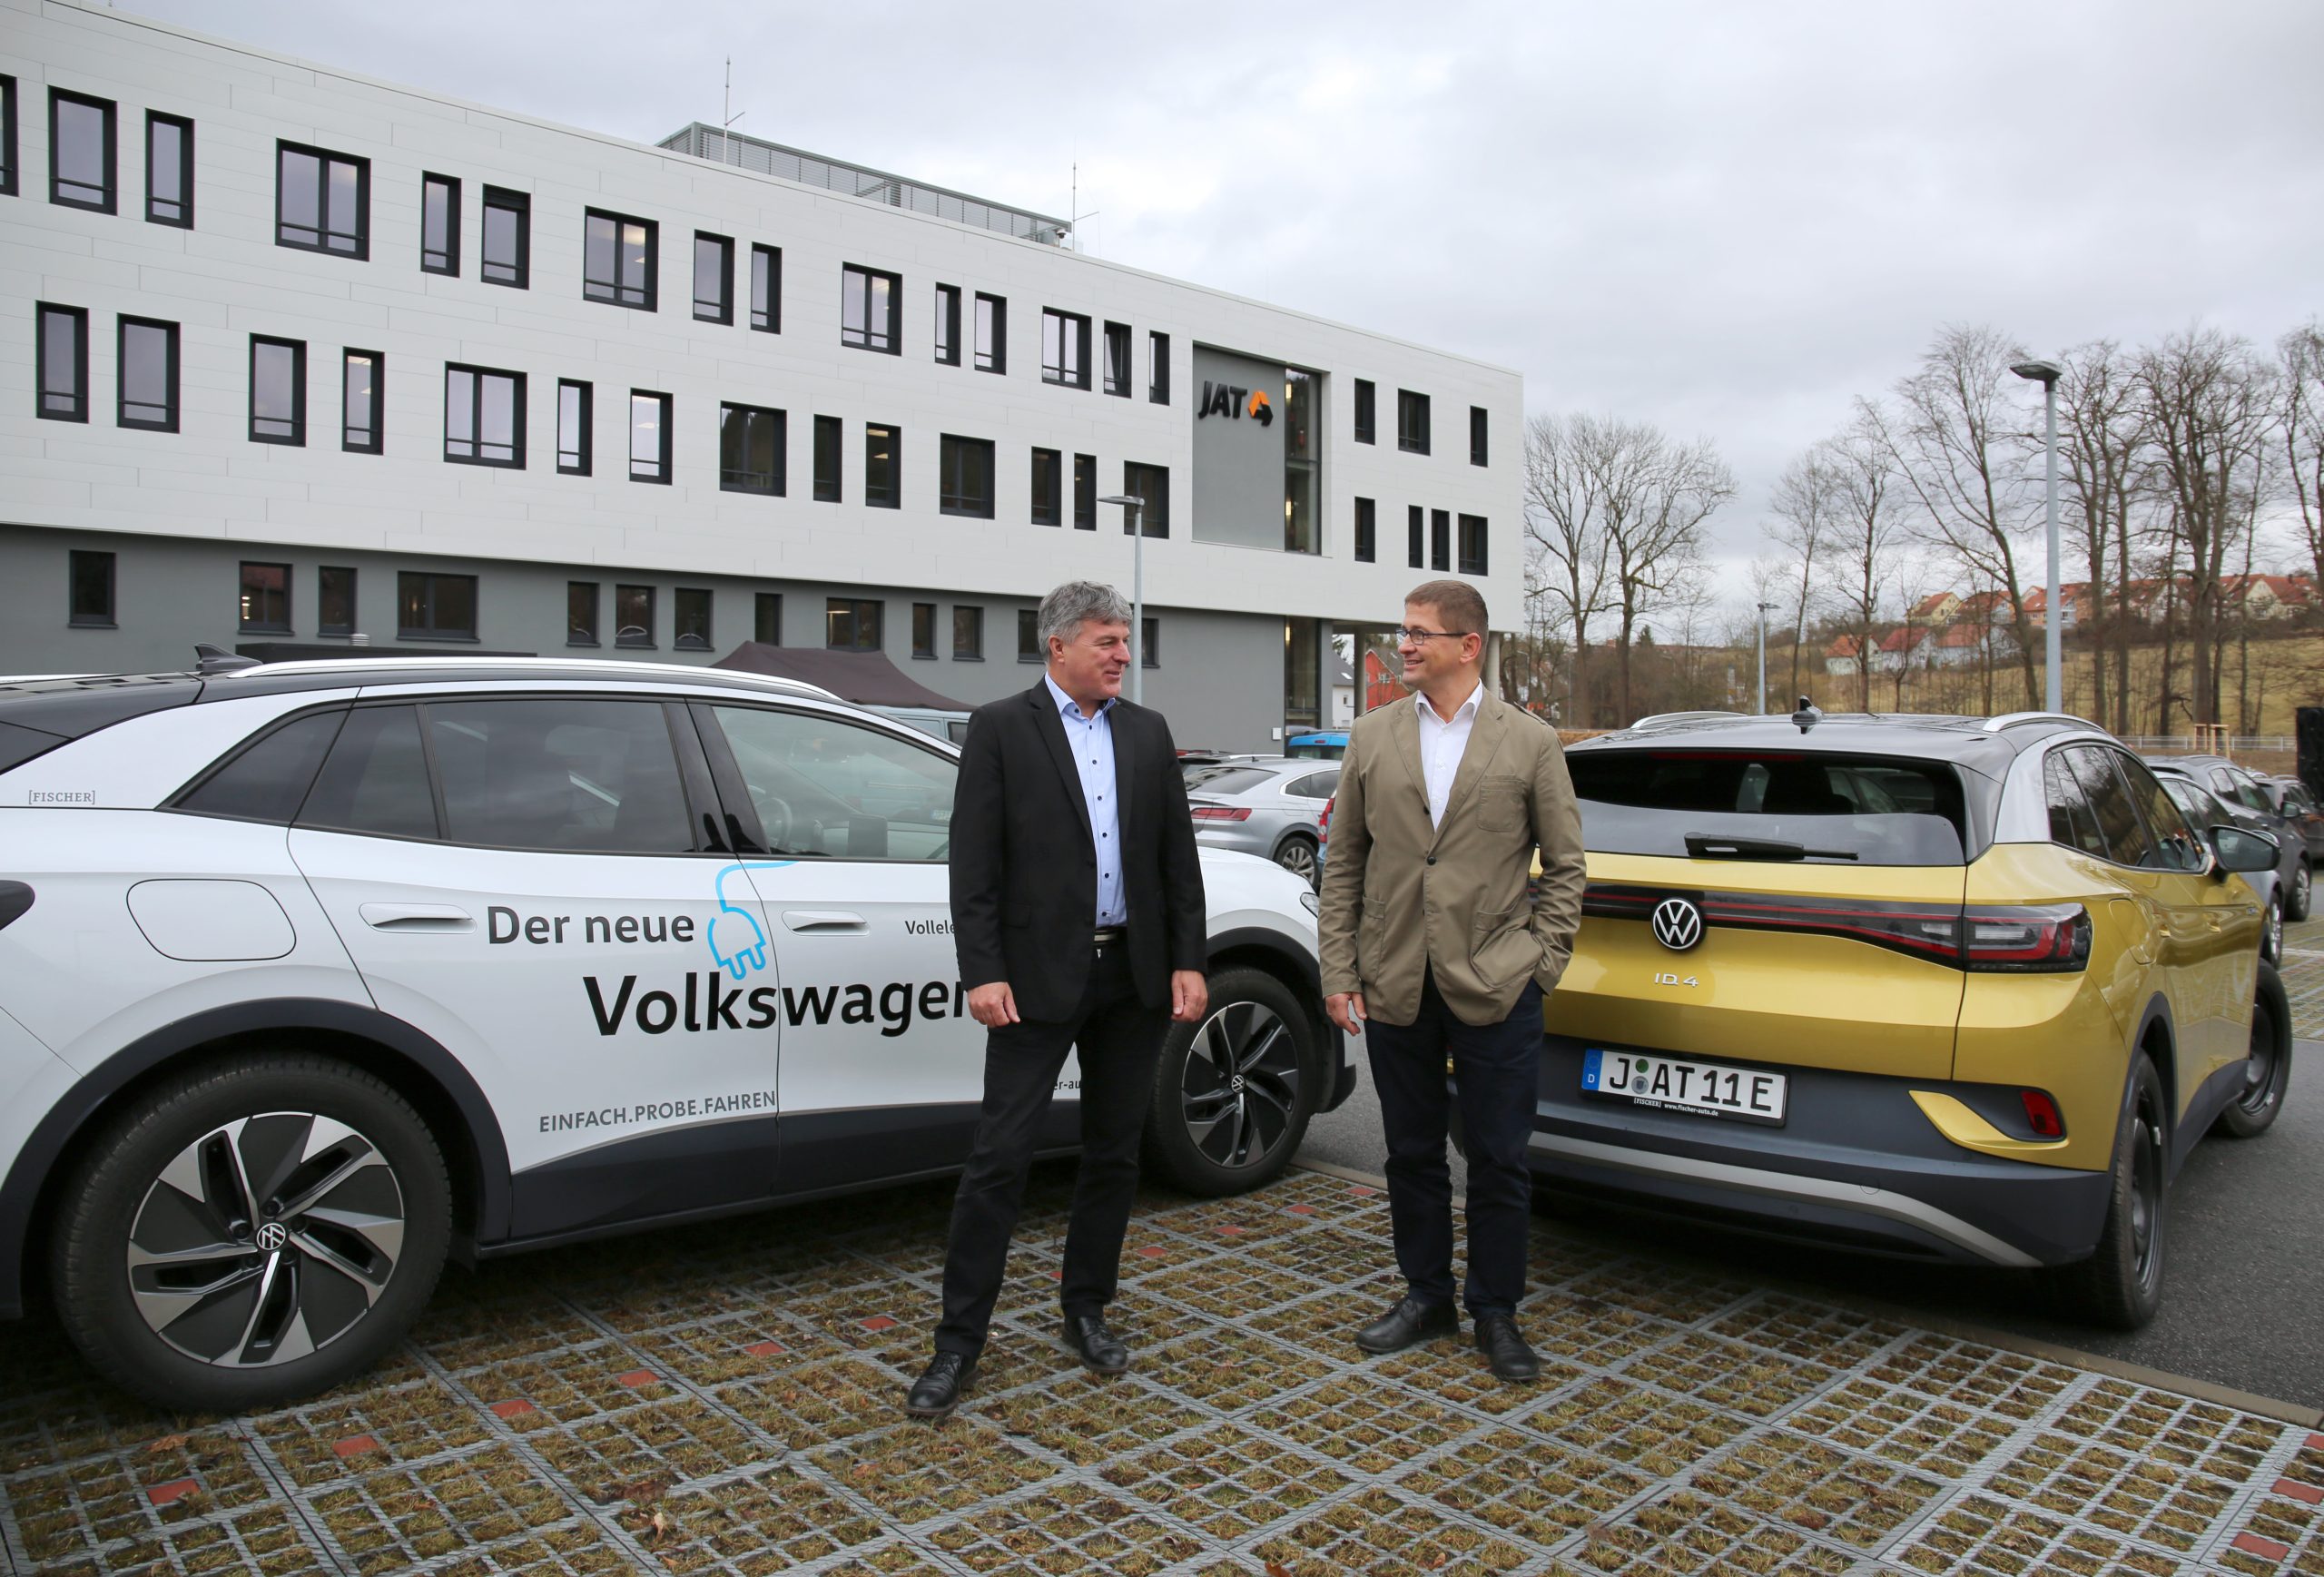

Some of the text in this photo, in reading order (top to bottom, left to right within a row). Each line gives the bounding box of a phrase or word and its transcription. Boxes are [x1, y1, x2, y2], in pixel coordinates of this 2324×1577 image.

[1198, 380, 1247, 419] JAT
[487, 906, 694, 944] Der neue
[1588, 1074, 1595, 1083] D
[1664, 1103, 1718, 1117] www.fischer-auto.de
